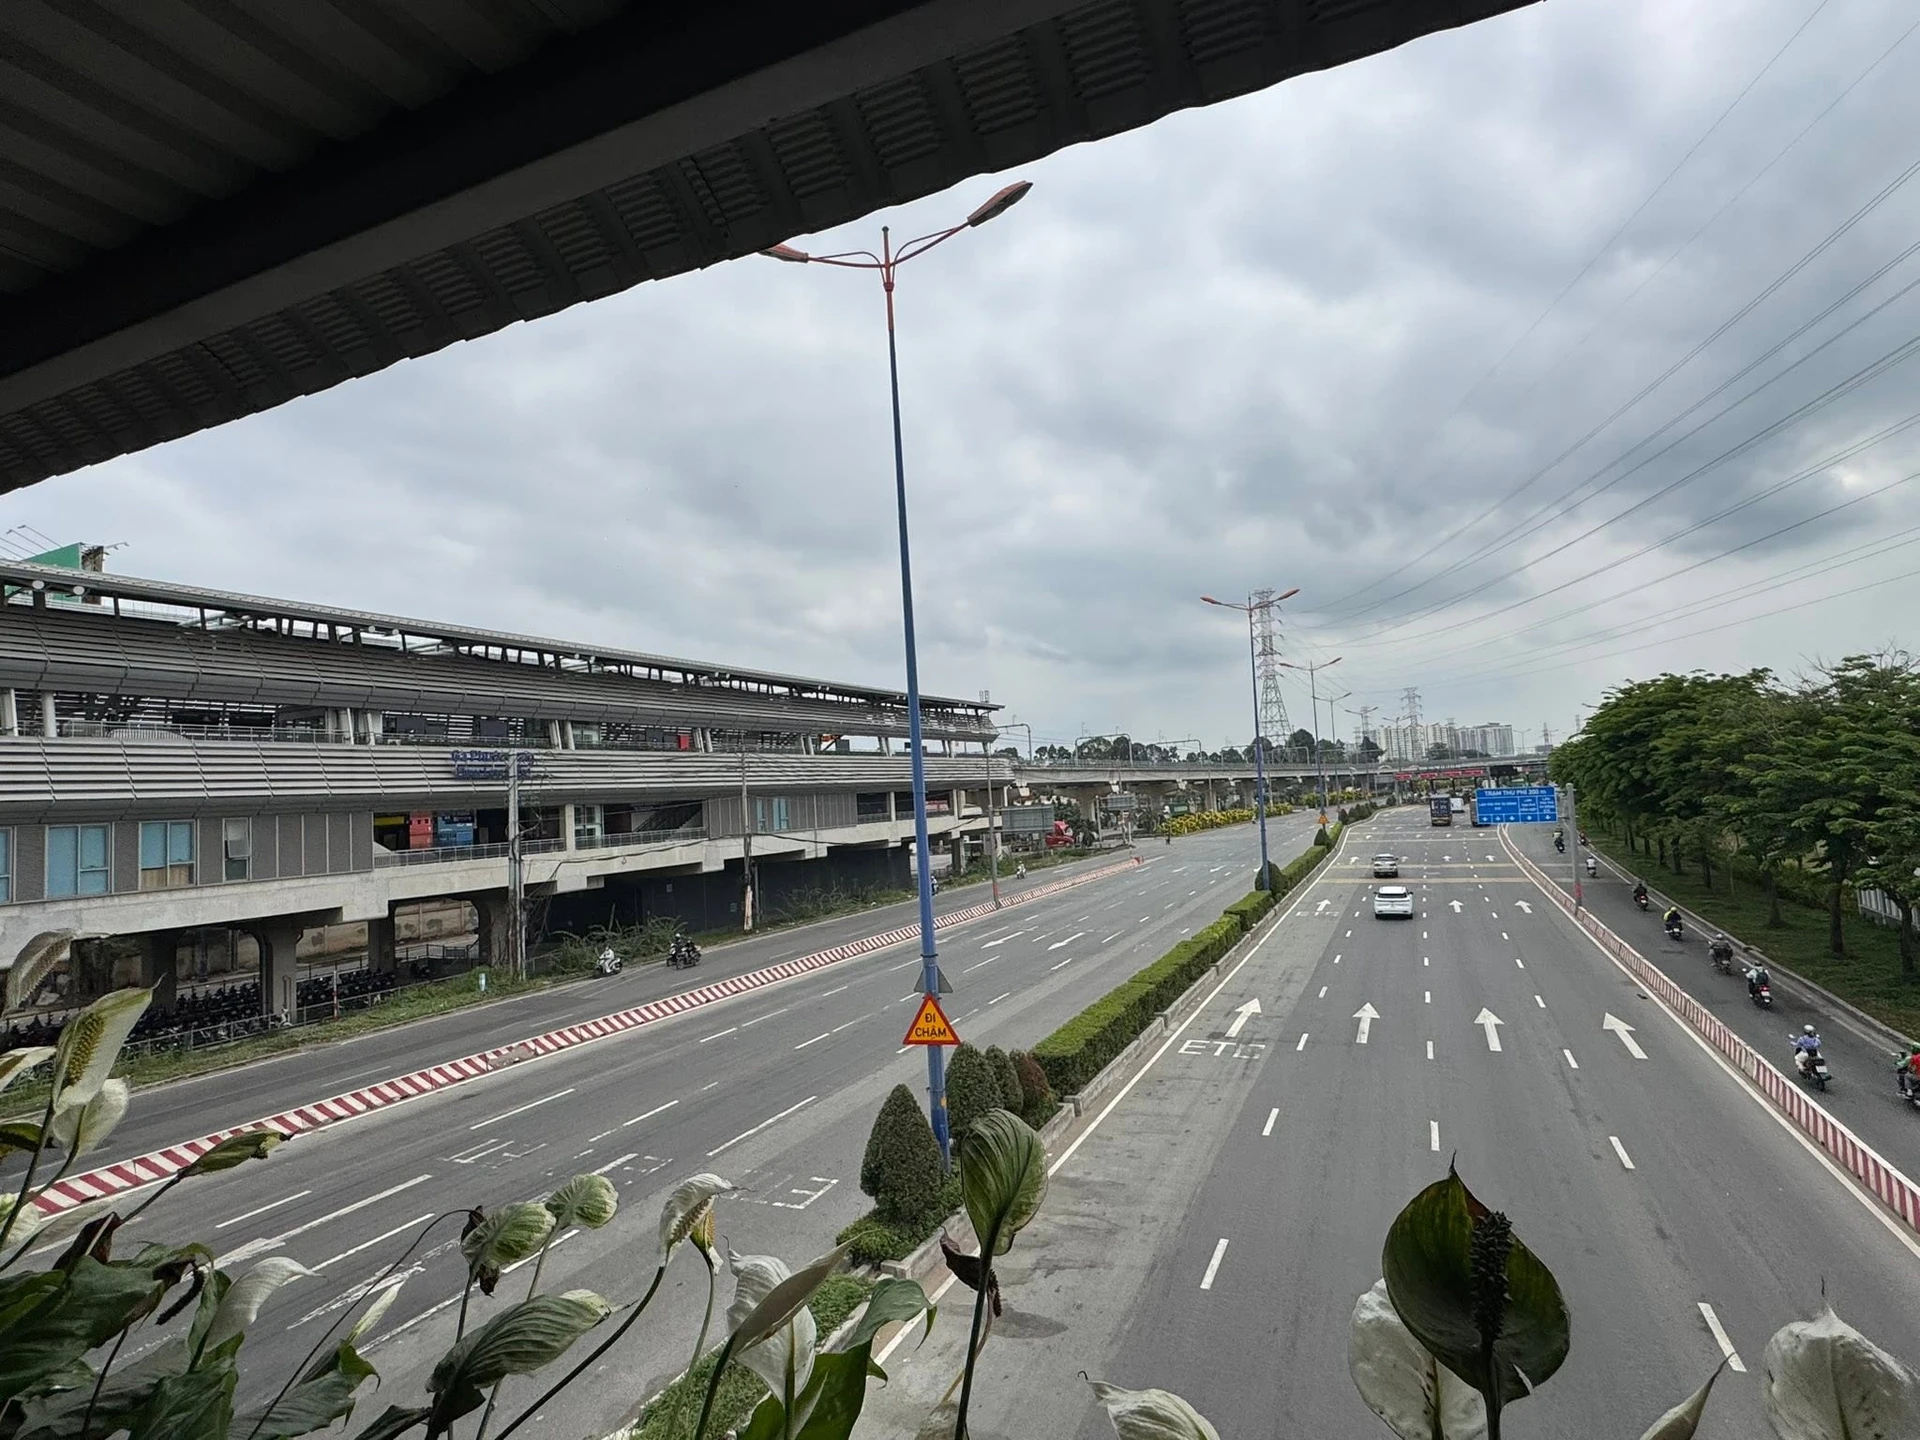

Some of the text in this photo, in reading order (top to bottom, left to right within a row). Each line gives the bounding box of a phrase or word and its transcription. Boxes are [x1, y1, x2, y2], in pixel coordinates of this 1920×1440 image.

[924, 1013, 936, 1023] ĐI
[915, 1026, 947, 1040] CHẬM
[1177, 1039, 1266, 1060] ETC
